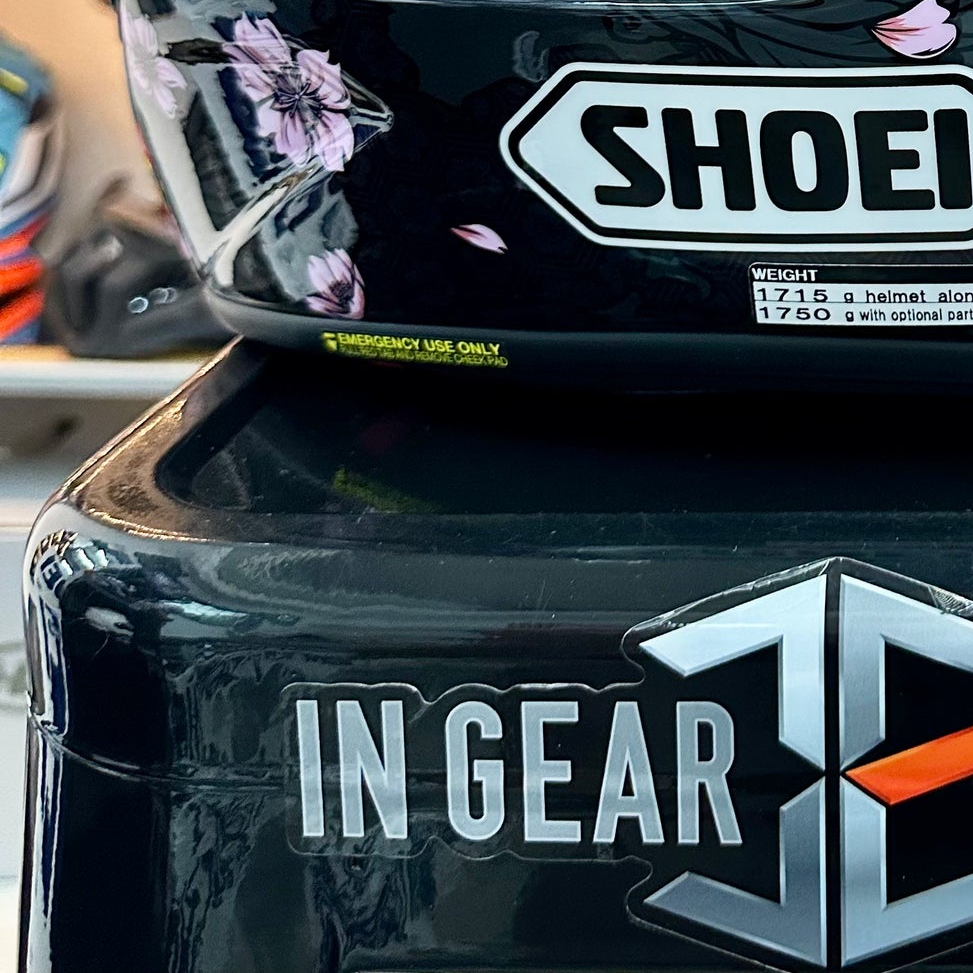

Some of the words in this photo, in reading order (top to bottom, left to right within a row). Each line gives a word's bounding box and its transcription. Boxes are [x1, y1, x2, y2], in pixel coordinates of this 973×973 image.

[580, 105, 973, 211] SHOEI
[752, 268, 818, 281] WEIGHT
[757, 288, 828, 302] 1715
[843, 291, 854, 303] g
[866, 290, 925, 303] helmet
[759, 307, 831, 319] 1750
[846, 310, 854, 322] g
[860, 309, 886, 321] with
[891, 308, 942, 322] optional
[336, 332, 420, 350] EMERGENCY
[422, 338, 456, 353] USE
[456, 341, 500, 356] ONLY
[296, 699, 407, 839] IN
[445, 700, 742, 844] GEAR
